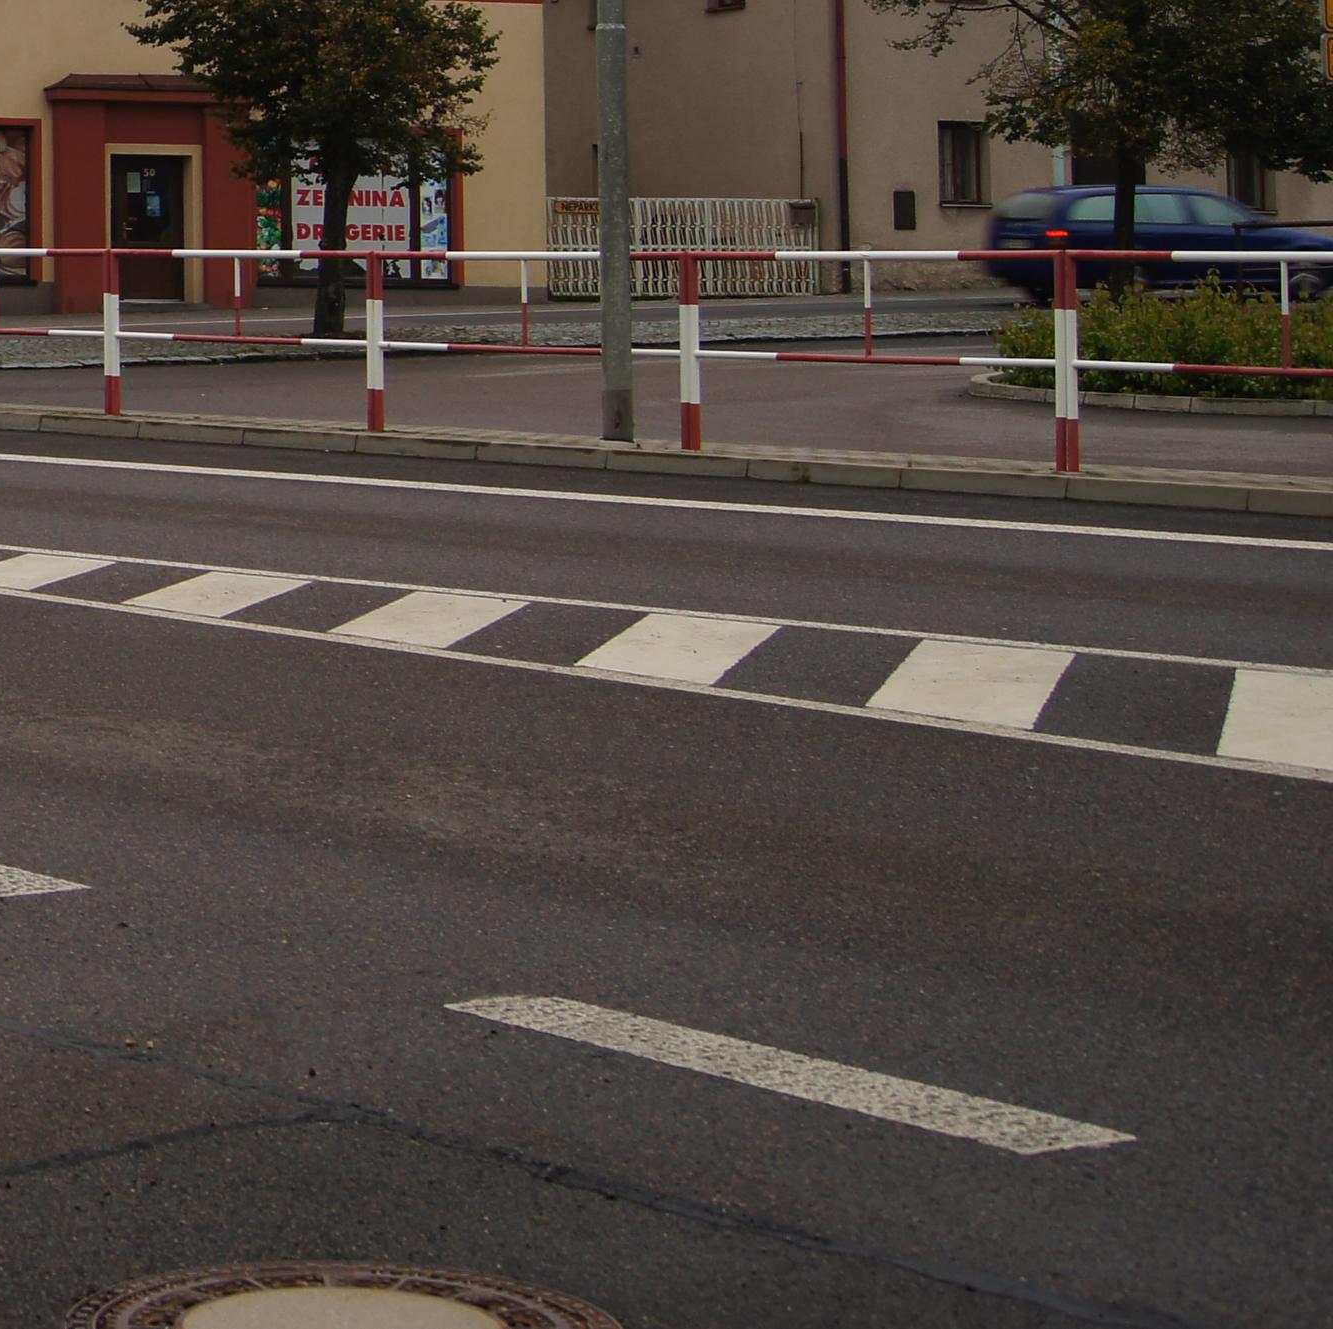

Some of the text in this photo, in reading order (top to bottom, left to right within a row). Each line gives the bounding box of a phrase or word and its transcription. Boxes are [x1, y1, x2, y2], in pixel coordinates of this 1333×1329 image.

[143, 168, 156, 177] 50
[296, 189, 405, 207] ZENINA
[296, 223, 406, 241] DRGERIE
